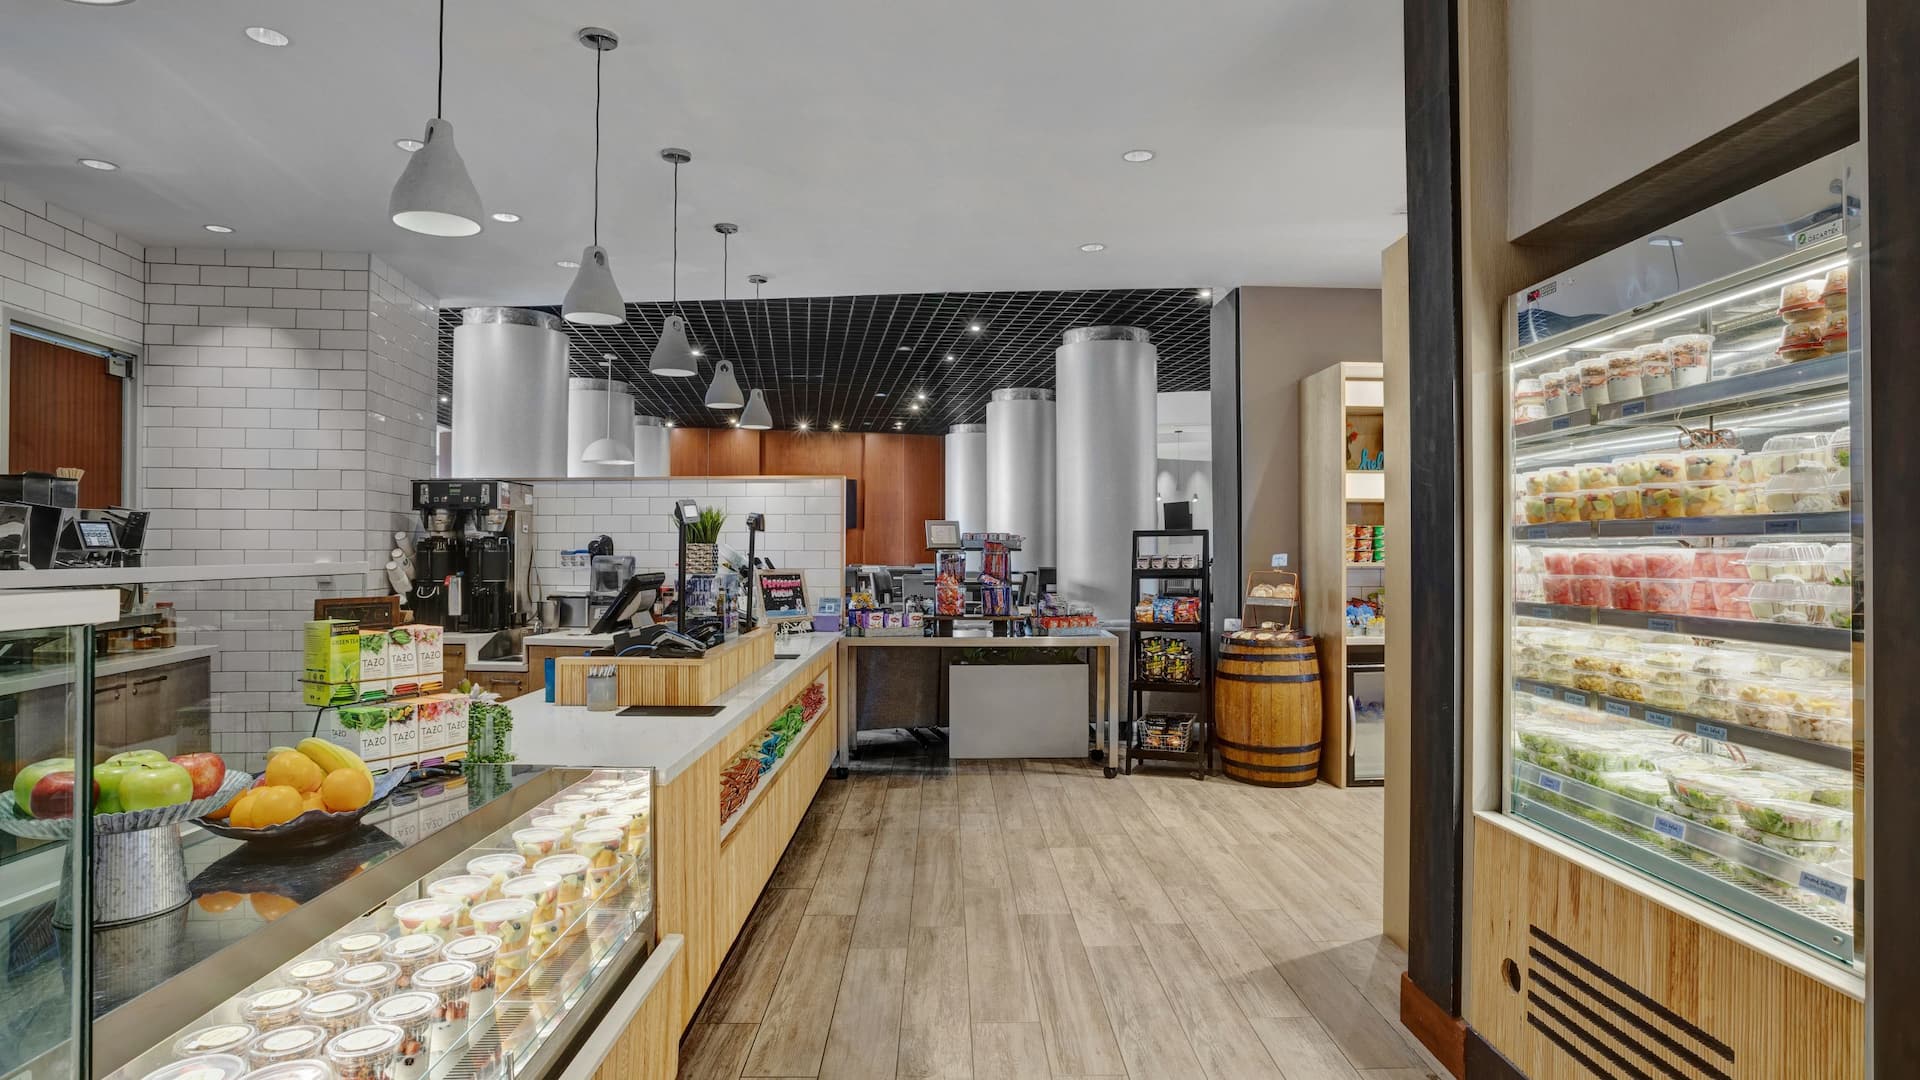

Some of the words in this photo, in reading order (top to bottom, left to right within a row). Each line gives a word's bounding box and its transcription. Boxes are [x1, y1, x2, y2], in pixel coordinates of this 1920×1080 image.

[391, 652, 414, 662] TAZO
[421, 650, 441, 660] TAZO
[362, 657, 386, 668] TAZO
[422, 724, 443, 735] TAZO
[447, 720, 467, 731] TAZO
[332, 729, 347, 738] TAZO
[393, 730, 416, 742] TAZO
[362, 736, 387, 748] TAZO
